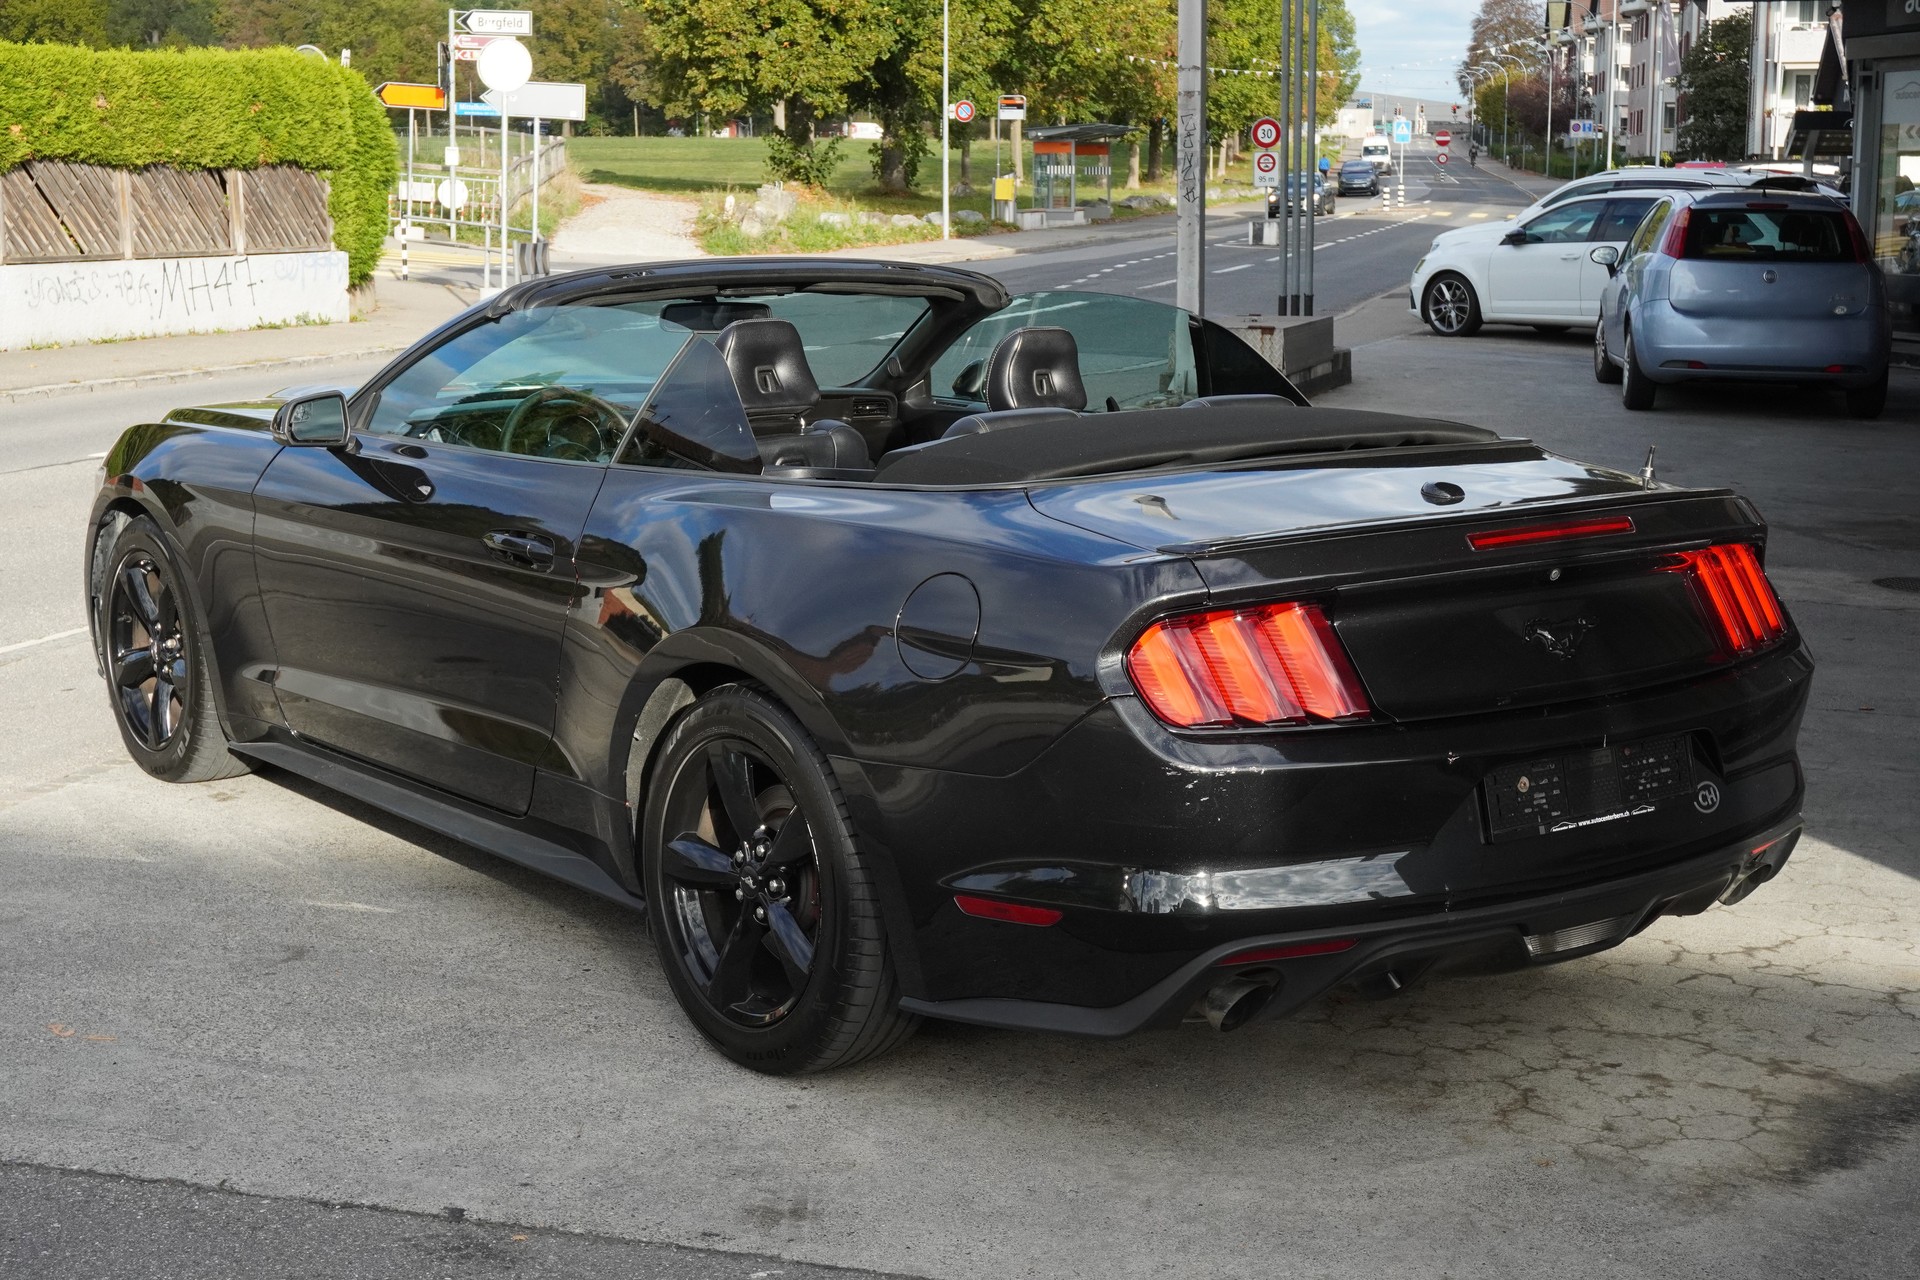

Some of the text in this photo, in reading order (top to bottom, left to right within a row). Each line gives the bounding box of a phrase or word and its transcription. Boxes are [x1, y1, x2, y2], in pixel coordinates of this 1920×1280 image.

[1261, 129, 1272, 139] 30
[1699, 787, 1716, 806] CH
[1578, 810, 1630, 826] www.autocenterbern.ch
